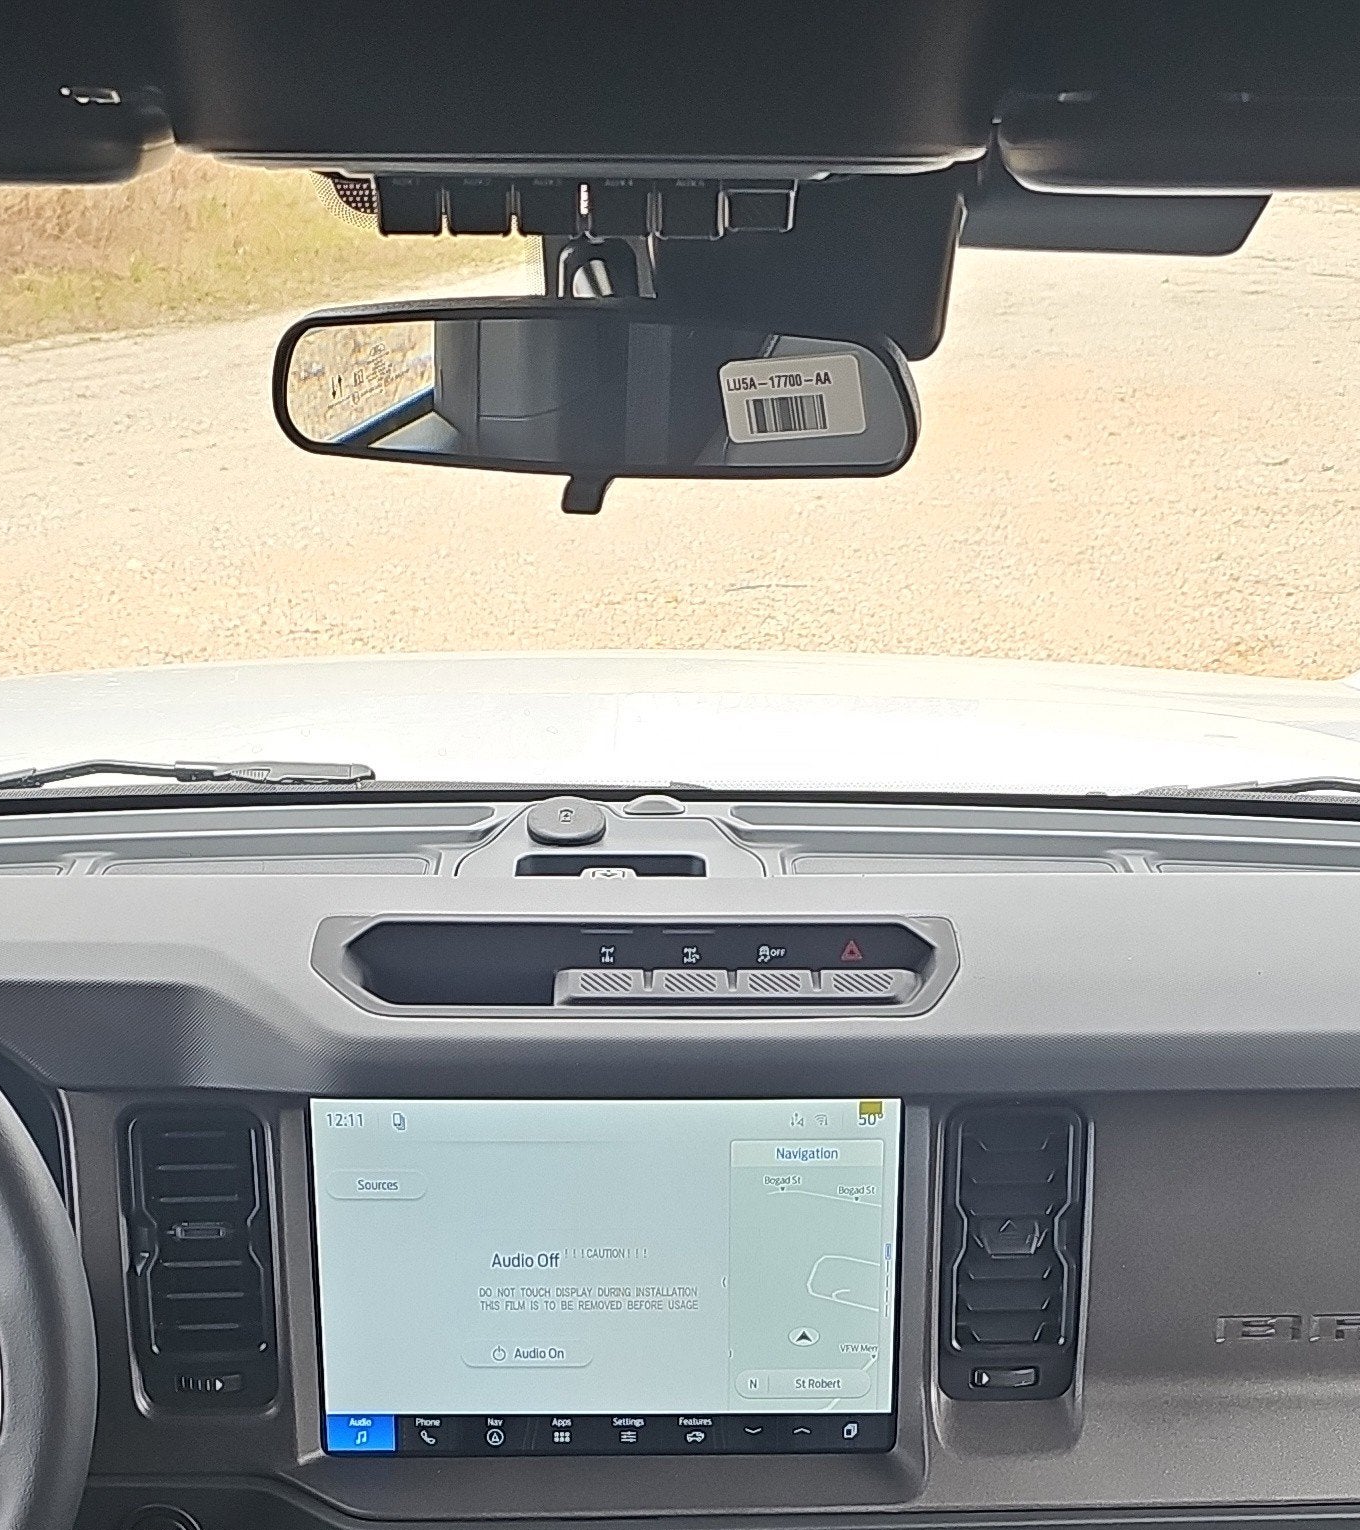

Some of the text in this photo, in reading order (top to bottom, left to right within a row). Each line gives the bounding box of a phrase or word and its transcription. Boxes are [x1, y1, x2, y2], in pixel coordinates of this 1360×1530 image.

[727, 372, 832, 391] LU5A-17700-AA
[326, 1113, 364, 1127] 12:11
[776, 1147, 839, 1161] Navigation
[357, 1179, 399, 1191] Sources
[764, 1176, 801, 1186] Bogad St
[838, 1186, 875, 1196] Bogad St
[491, 1252, 560, 1268] Audio Off
[479, 1287, 698, 1298] DO NOT TOUCH DISPLAY DURING INSTALLATION
[480, 1300, 699, 1311] THIS FILM IS TO BE REMOVED BEFORE USAGE
[514, 1348, 565, 1359] Audio On
[749, 1379, 758, 1389] N
[795, 1379, 841, 1389] St Robert
[349, 1418, 372, 1427] Audio
[415, 1418, 441, 1427] Phone
[487, 1418, 503, 1427] Nav
[552, 1418, 572, 1428] Apps
[612, 1417, 645, 1428] Settings
[678, 1417, 713, 1426] Features
